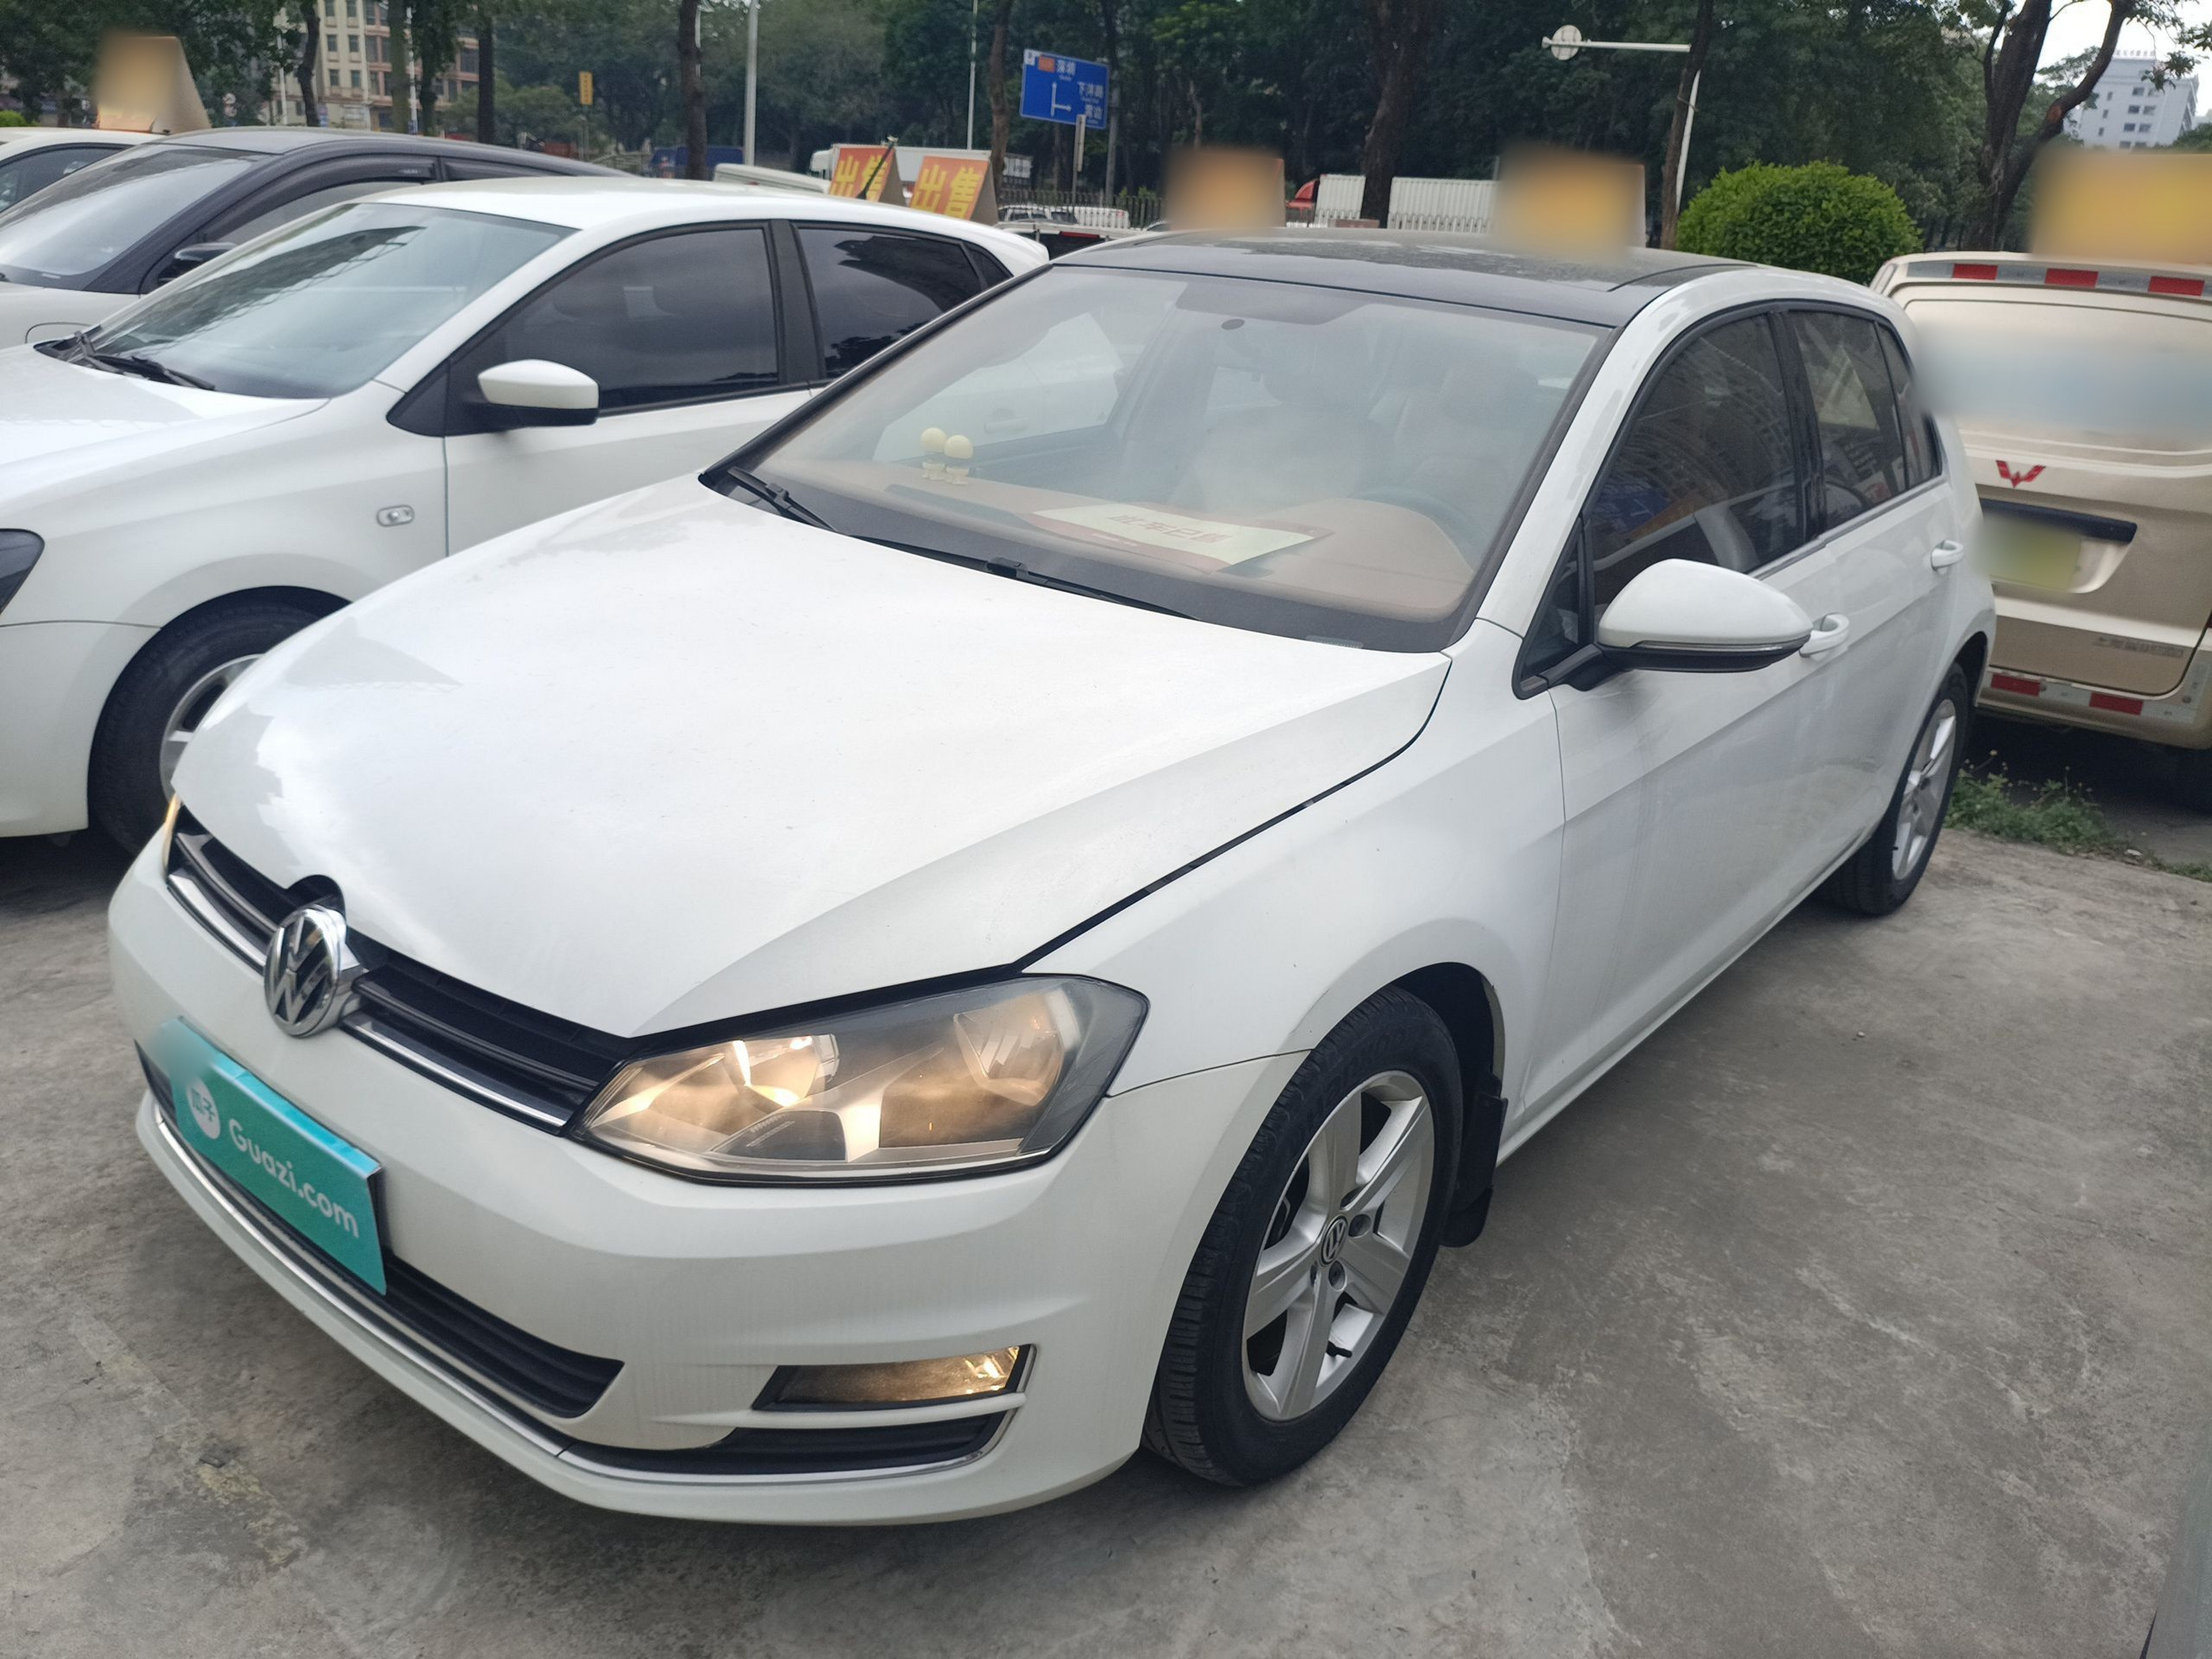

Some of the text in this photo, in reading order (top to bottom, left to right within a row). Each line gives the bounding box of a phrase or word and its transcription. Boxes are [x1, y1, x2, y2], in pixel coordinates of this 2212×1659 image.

[830, 155, 888, 202] 出售
[910, 165, 981, 219] 出售
[229, 1119, 360, 1240] Guazi.com
